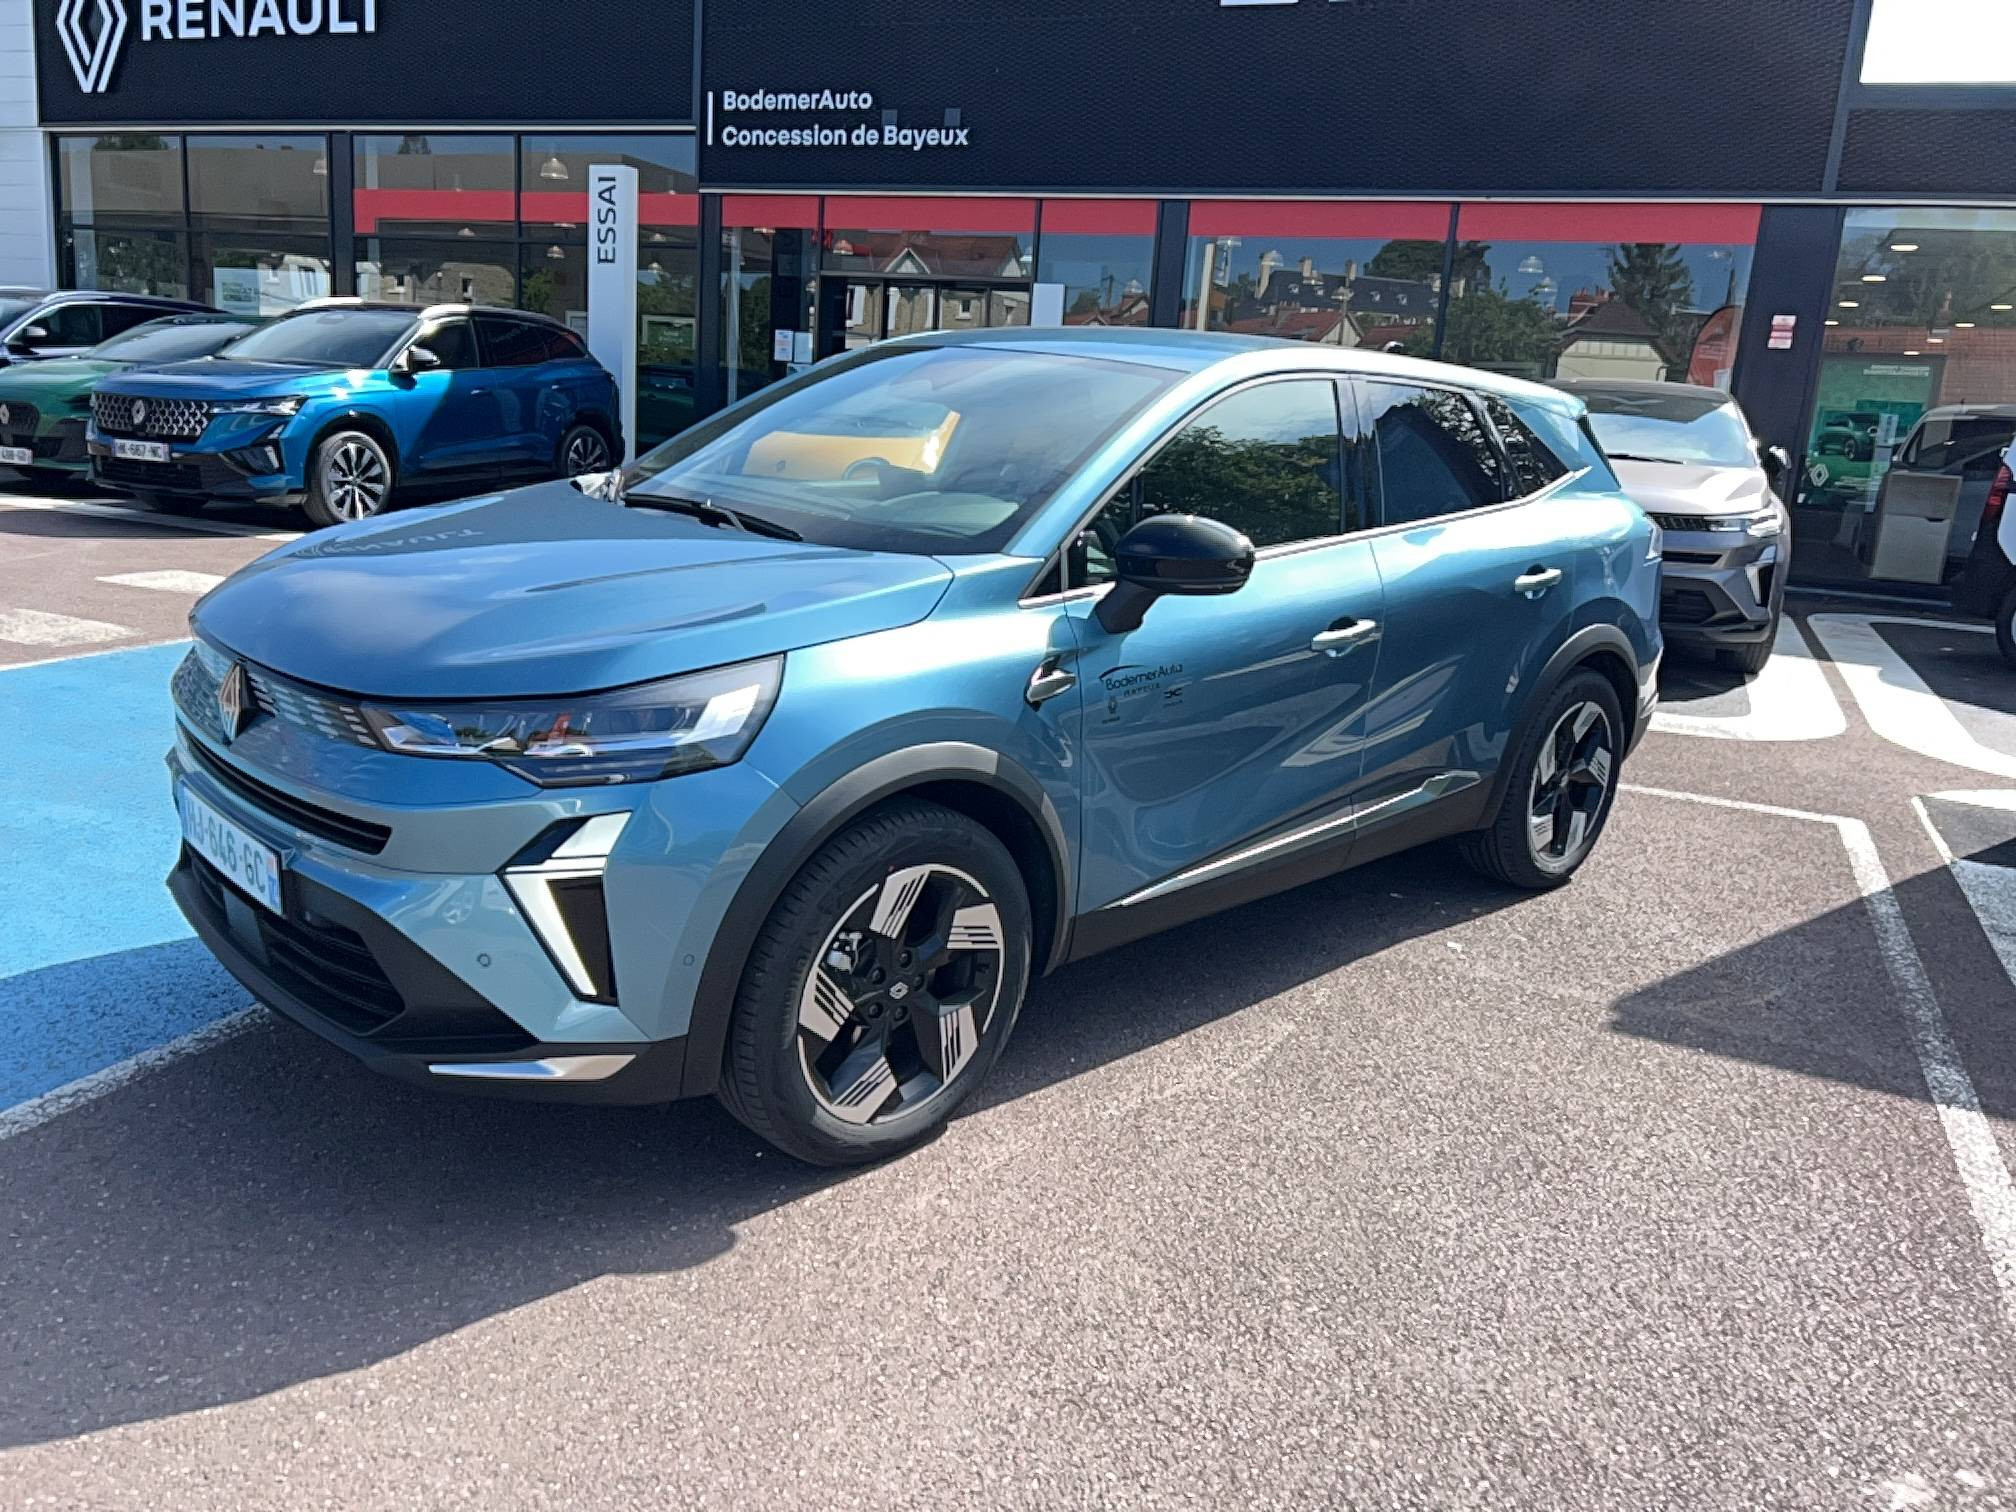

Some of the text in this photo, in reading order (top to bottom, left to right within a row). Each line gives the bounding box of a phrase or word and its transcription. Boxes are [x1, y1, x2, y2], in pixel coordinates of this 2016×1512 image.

[722, 88, 873, 111] BodemerAuto
[722, 124, 969, 151] Concession de Bayeux
[597, 176, 616, 264] ESSAI
